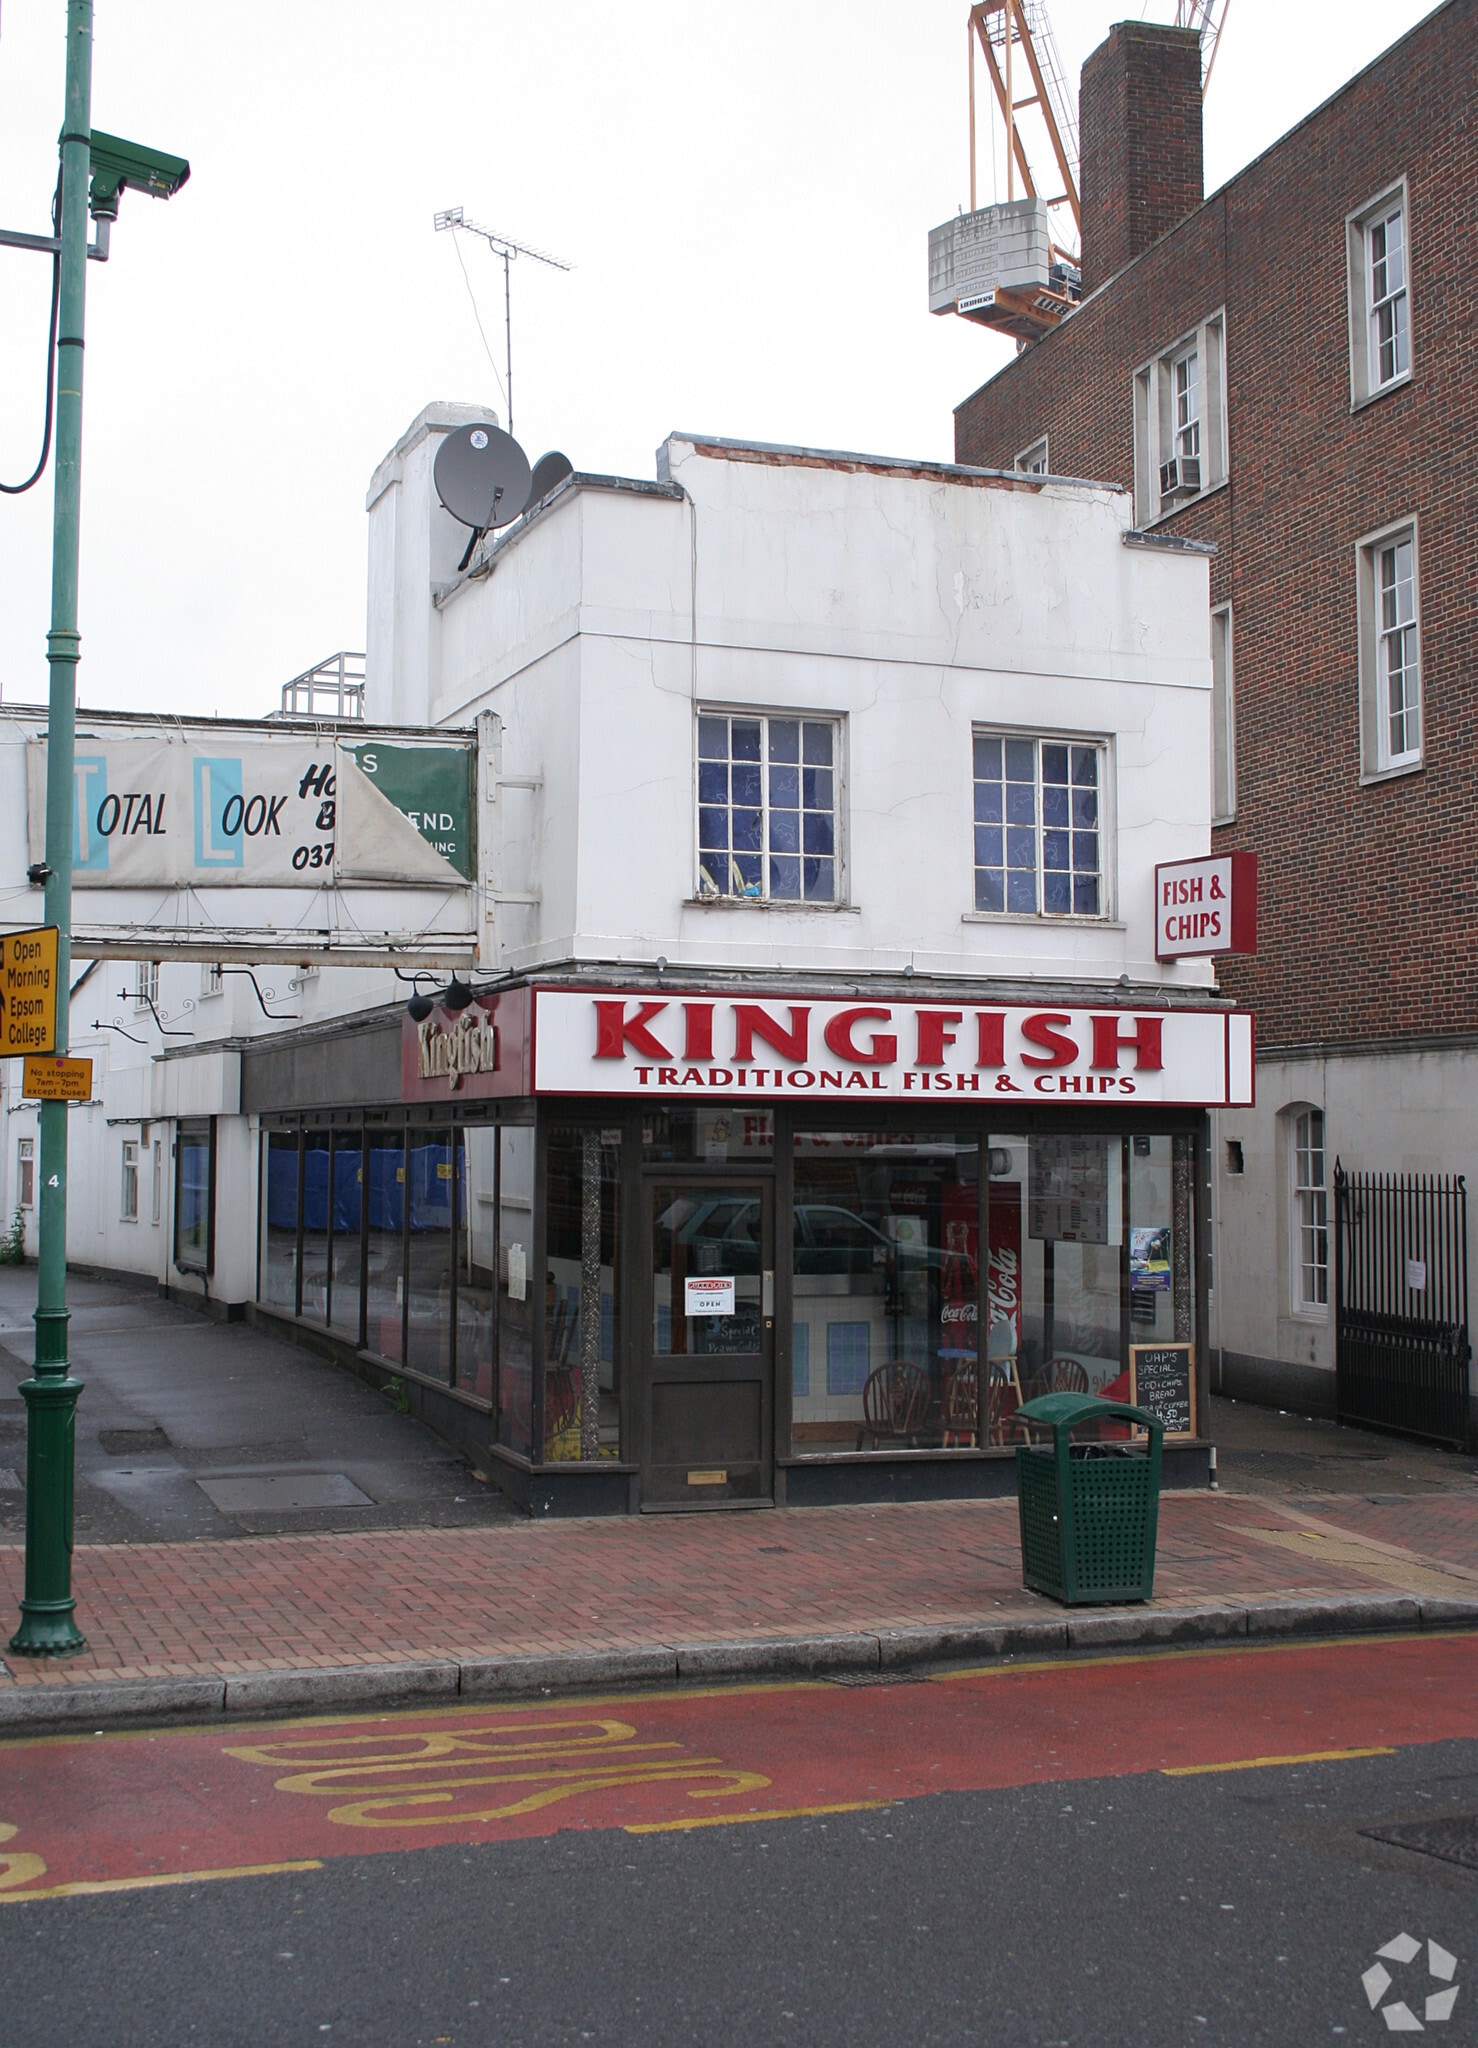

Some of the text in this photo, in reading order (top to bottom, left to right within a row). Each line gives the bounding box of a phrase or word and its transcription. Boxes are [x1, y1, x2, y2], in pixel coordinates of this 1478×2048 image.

[202, 764, 288, 859] LOOK
[1163, 874, 1226, 906] FISH &
[1165, 911, 1221, 941] CHIPS
[14, 939, 41, 963] Open
[8, 965, 50, 989] Morning
[10, 996, 44, 1020] Epsom
[8, 1022, 47, 1047] College
[592, 1000, 1165, 1070] KINGFISH
[418, 1009, 494, 1091] Kingfish
[30, 1068, 85, 1079] No stopping
[633, 1066, 1137, 1094] TRADITIONAL FISH & CHIPS
[27, 1088, 87, 1096] except buses
[48, 1174, 60, 1187] 4
[1149, 1388, 1176, 1401] BREAD
